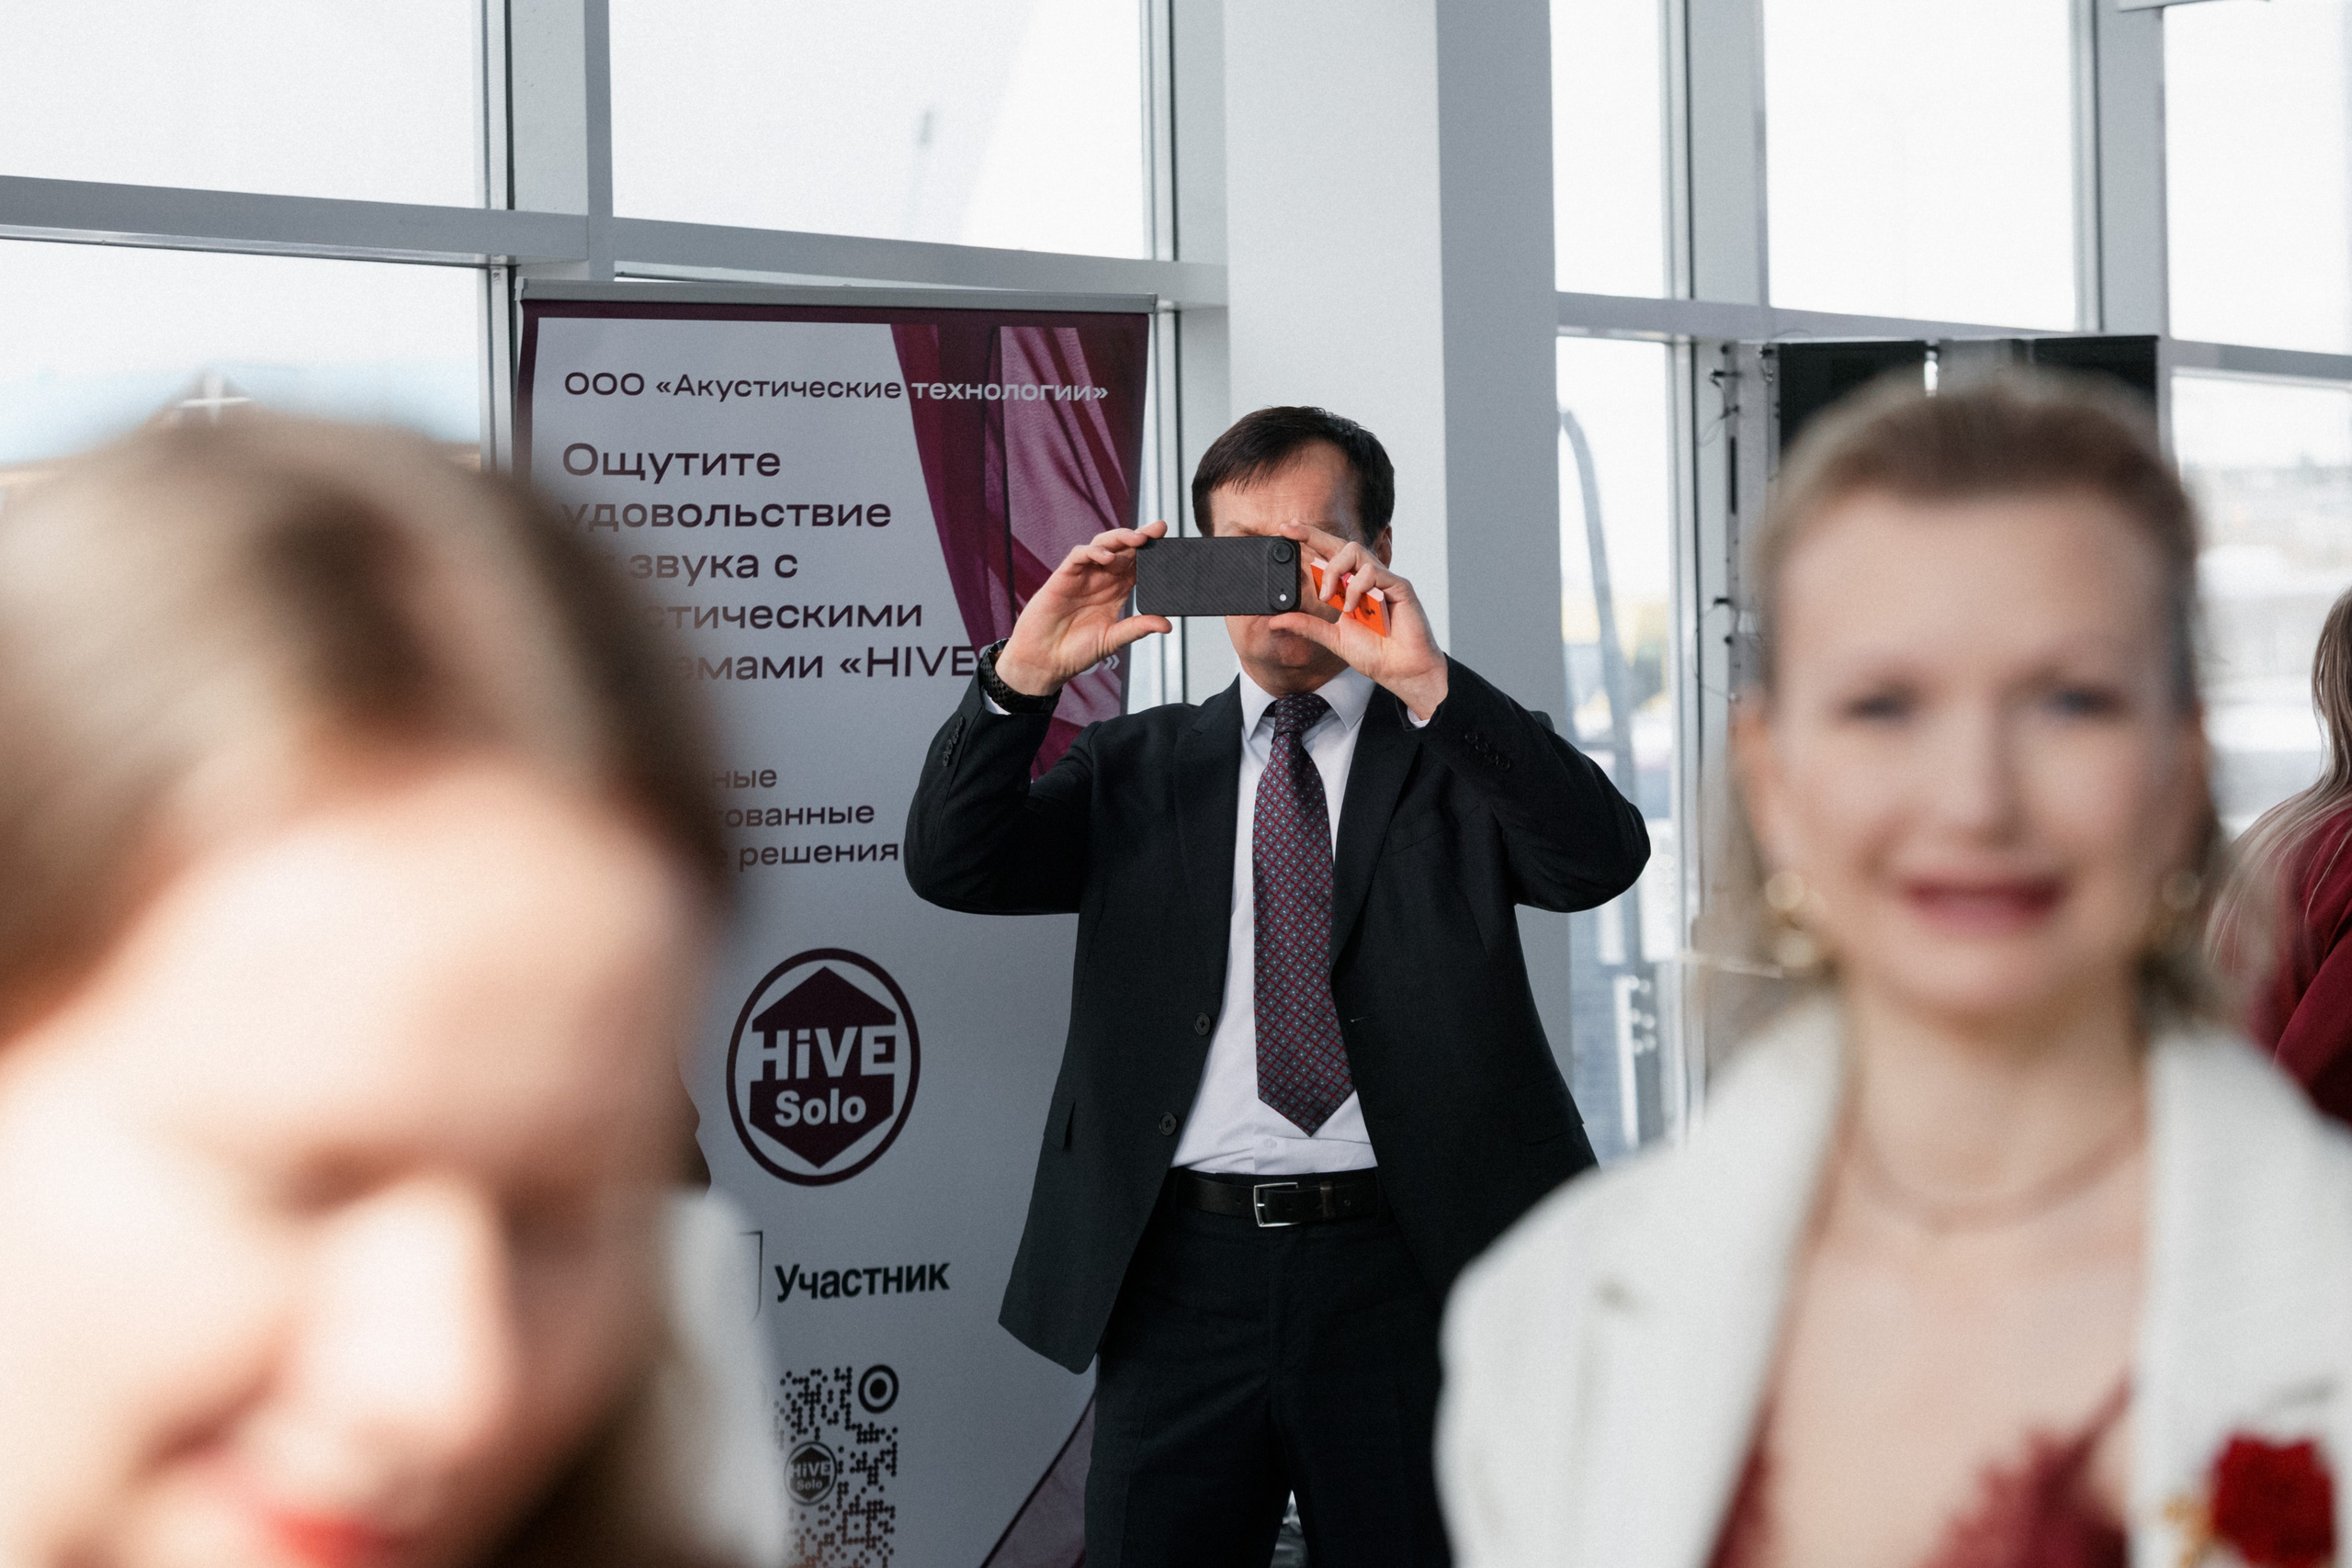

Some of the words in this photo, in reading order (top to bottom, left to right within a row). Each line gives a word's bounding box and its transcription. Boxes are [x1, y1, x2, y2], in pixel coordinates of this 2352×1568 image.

[656, 372, 902, 402] «Акустические
[910, 379, 1110, 402] технологии»
[562, 441, 781, 484] Ощутите
[560, 501, 891, 533] удовольствие
[629, 553, 760, 587] звука
[774, 553, 798, 580] с
[642, 603, 922, 630] стическими
[739, 841, 899, 873] решения
[775, 1088, 867, 1128] Solo
[774, 1262, 951, 1303] Участник
[797, 1478, 824, 1490] Solo
